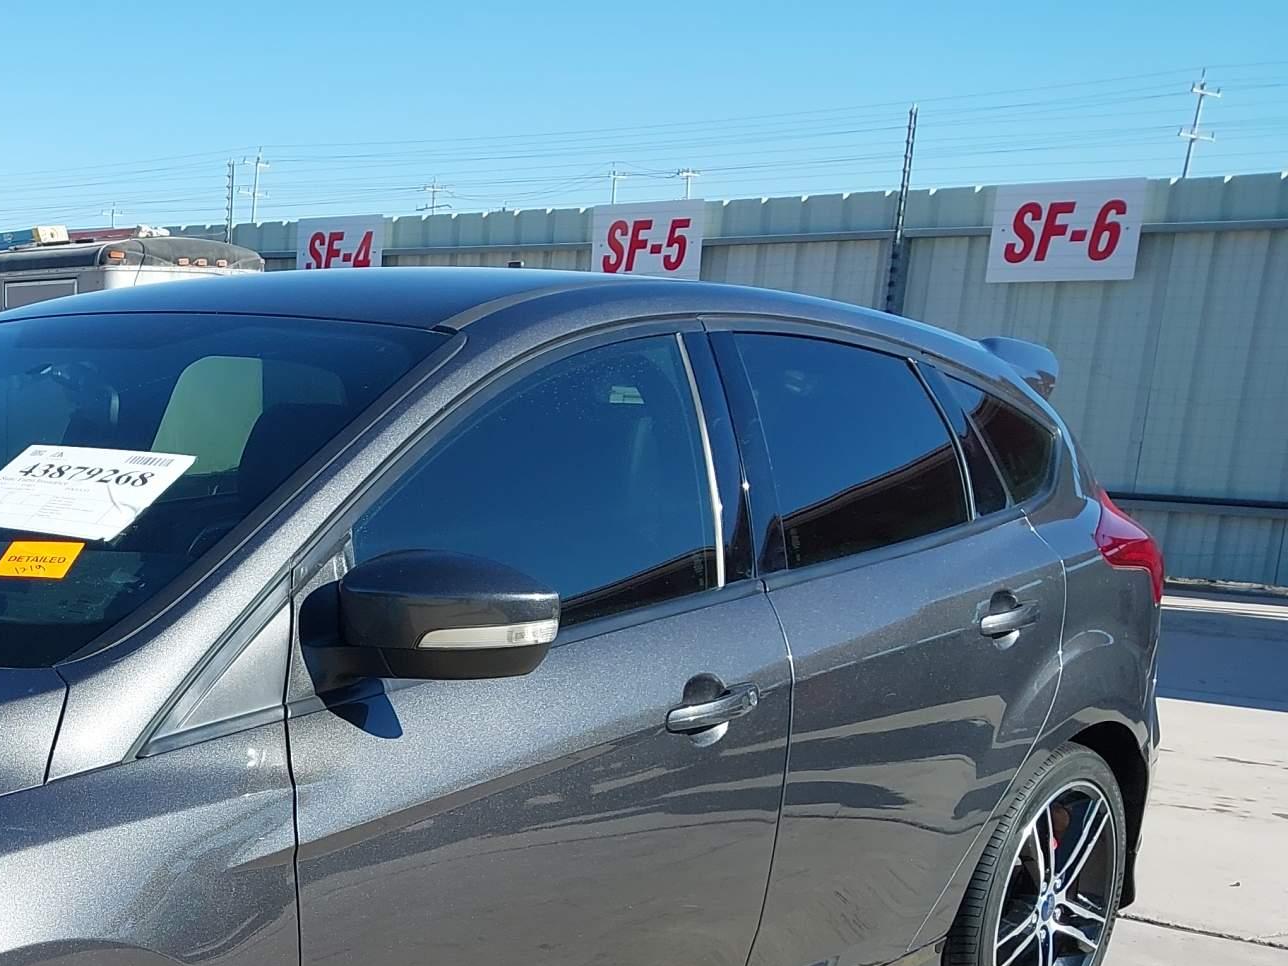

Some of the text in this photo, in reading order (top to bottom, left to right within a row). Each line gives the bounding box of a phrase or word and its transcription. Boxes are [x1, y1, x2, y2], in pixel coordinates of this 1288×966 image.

[306, 231, 374, 270] SF-4
[602, 218, 691, 274] SF-5
[1004, 199, 1127, 264] SF-6
[19, 462, 156, 488] 43879268
[7, 555, 66, 564] DETAILED
